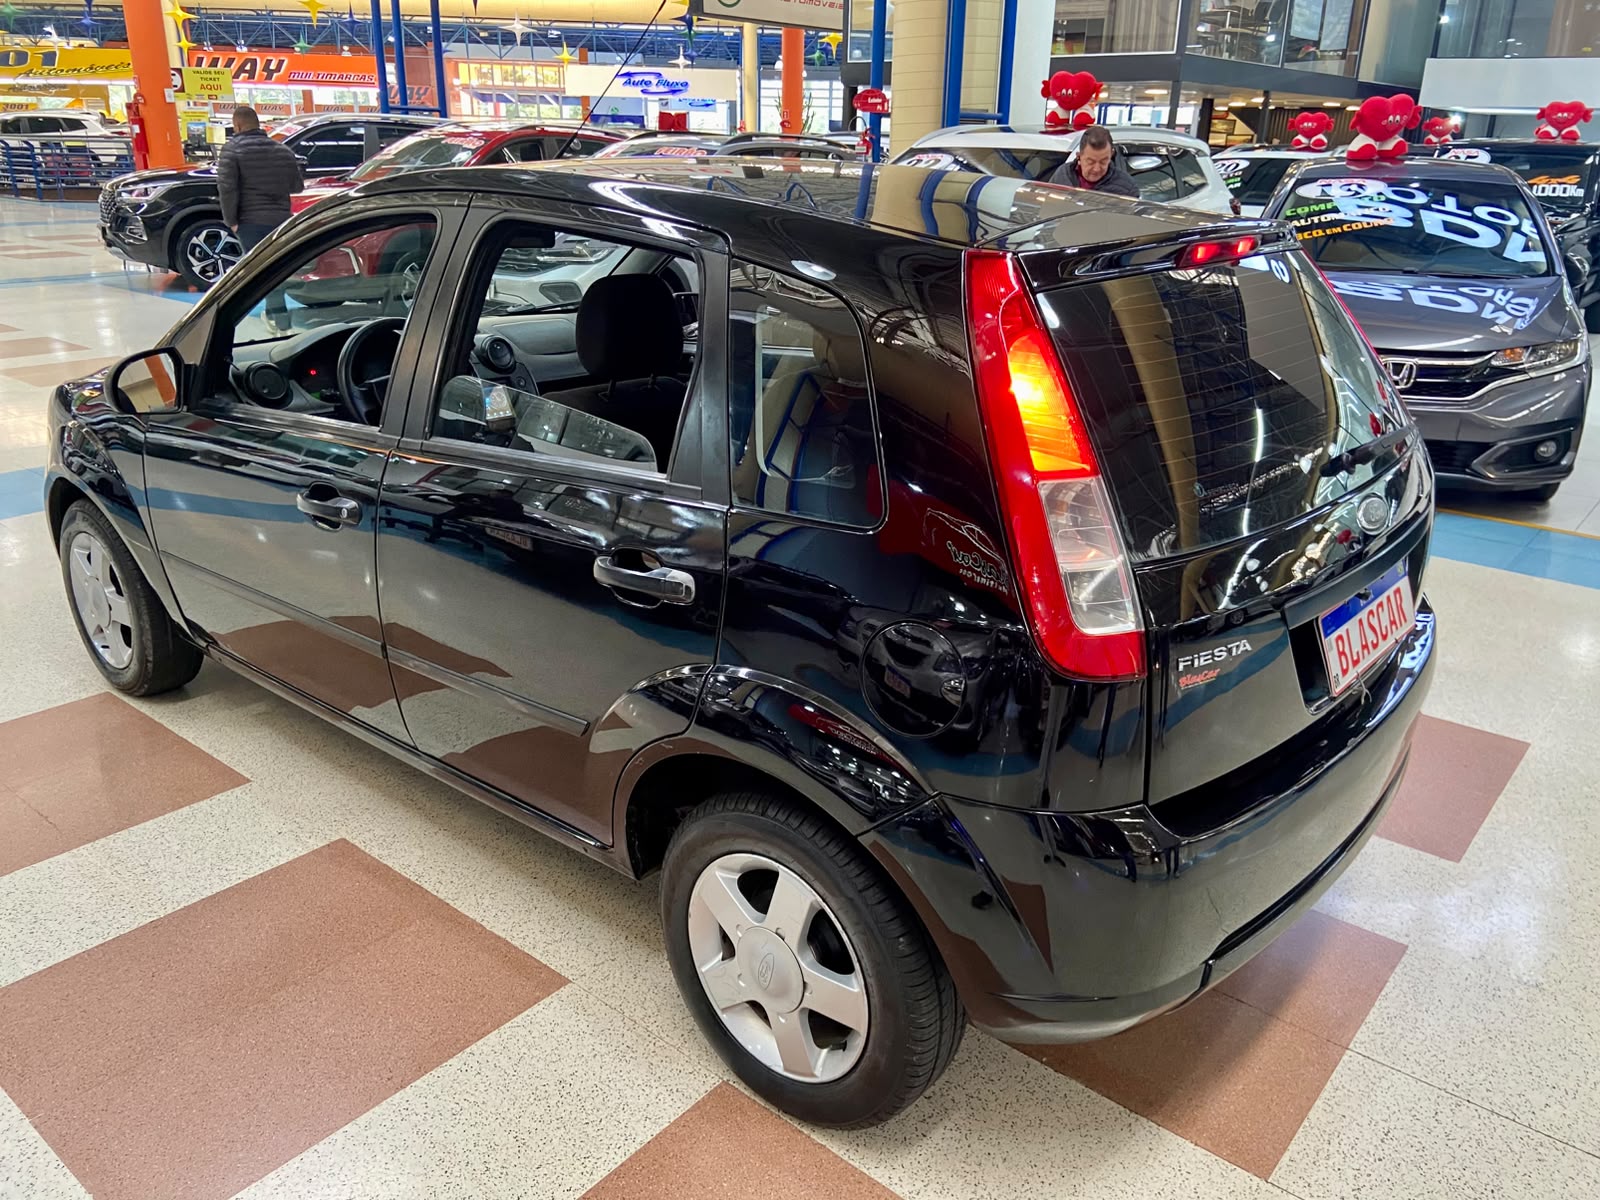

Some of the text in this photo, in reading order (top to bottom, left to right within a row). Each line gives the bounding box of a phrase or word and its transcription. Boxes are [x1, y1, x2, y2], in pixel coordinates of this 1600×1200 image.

[200, 83, 223, 91] AQUI
[622, 78, 689, 88] Auto Fluxo
[1335, 586, 1408, 678] BLASCAR
